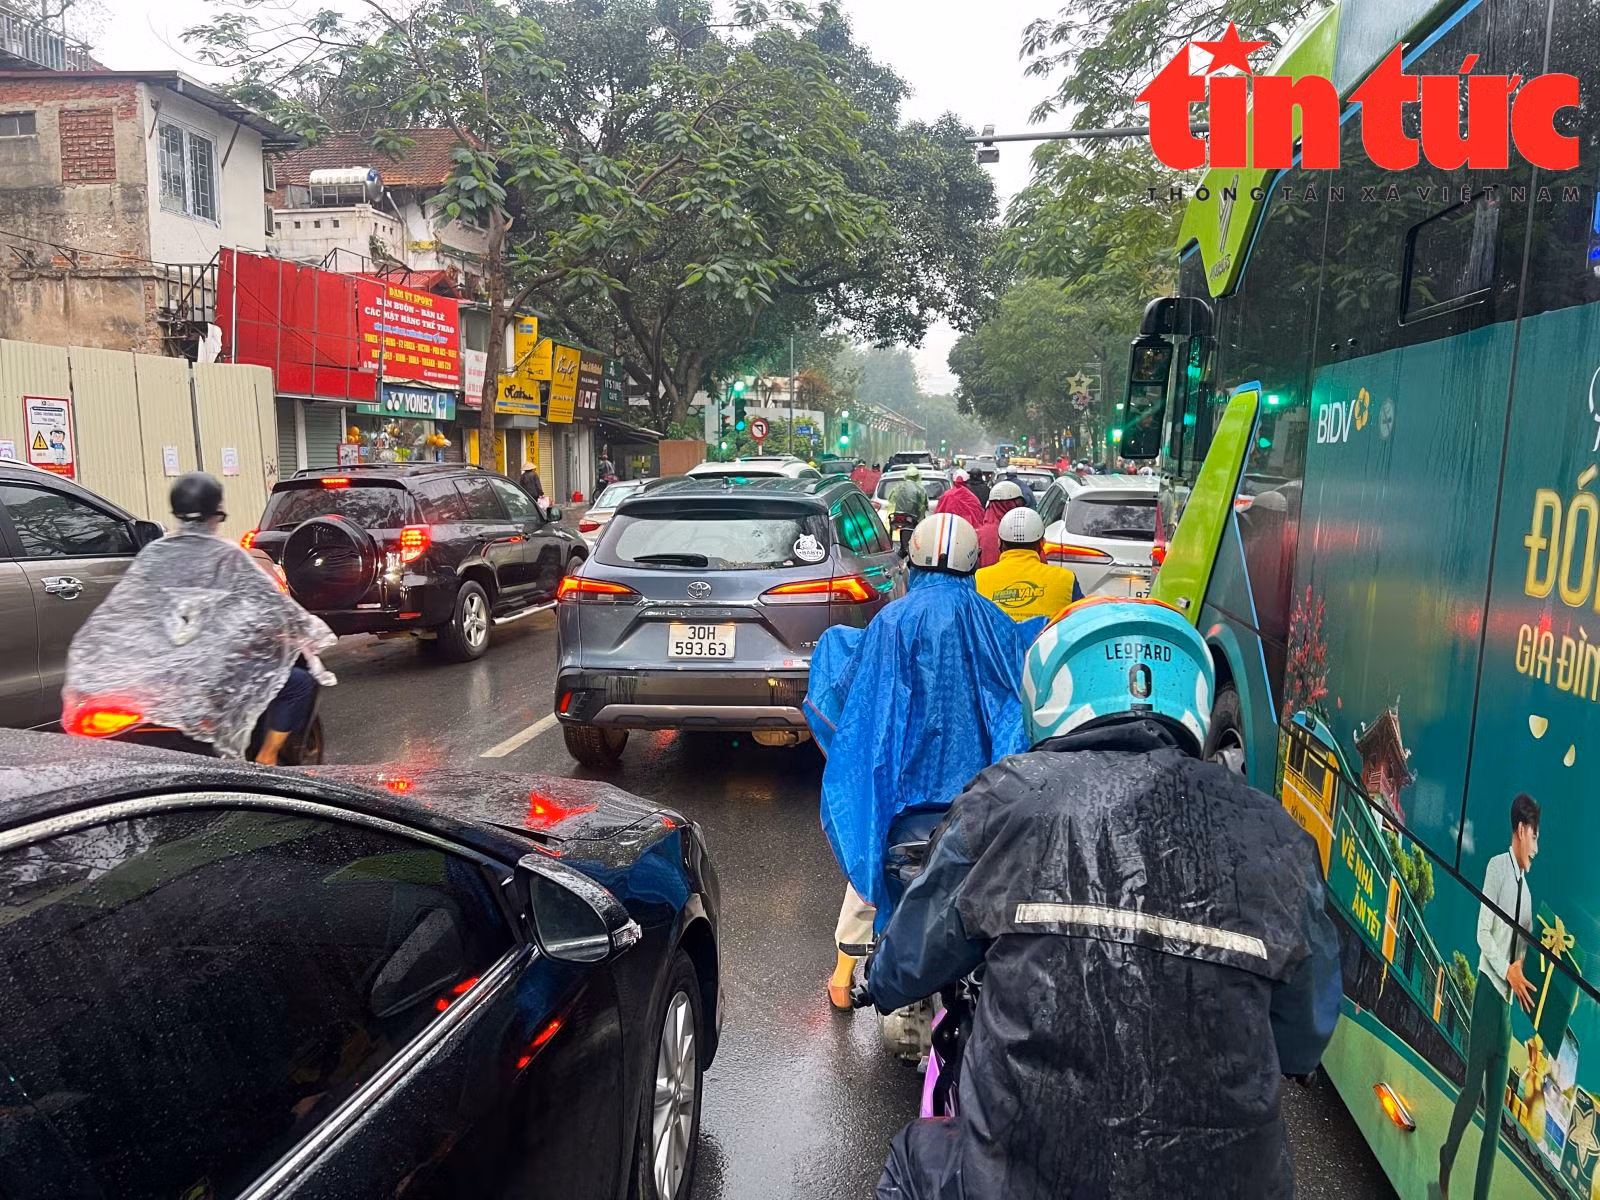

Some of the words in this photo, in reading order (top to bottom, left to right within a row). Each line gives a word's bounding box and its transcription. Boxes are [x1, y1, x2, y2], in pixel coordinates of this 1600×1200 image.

[404, 393, 434, 414] YONEX
[1316, 399, 1356, 444] BIDV
[1524, 464, 1600, 614] ĐÓ
[675, 641, 727, 656] 593.63
[688, 626, 716, 640] 30H
[1516, 623, 1555, 685] GIA
[1341, 827, 1356, 871] VỀ
[1355, 854, 1374, 900] NHÀ
[1351, 884, 1367, 924] ĂN
[1367, 909, 1382, 941] TẾT
